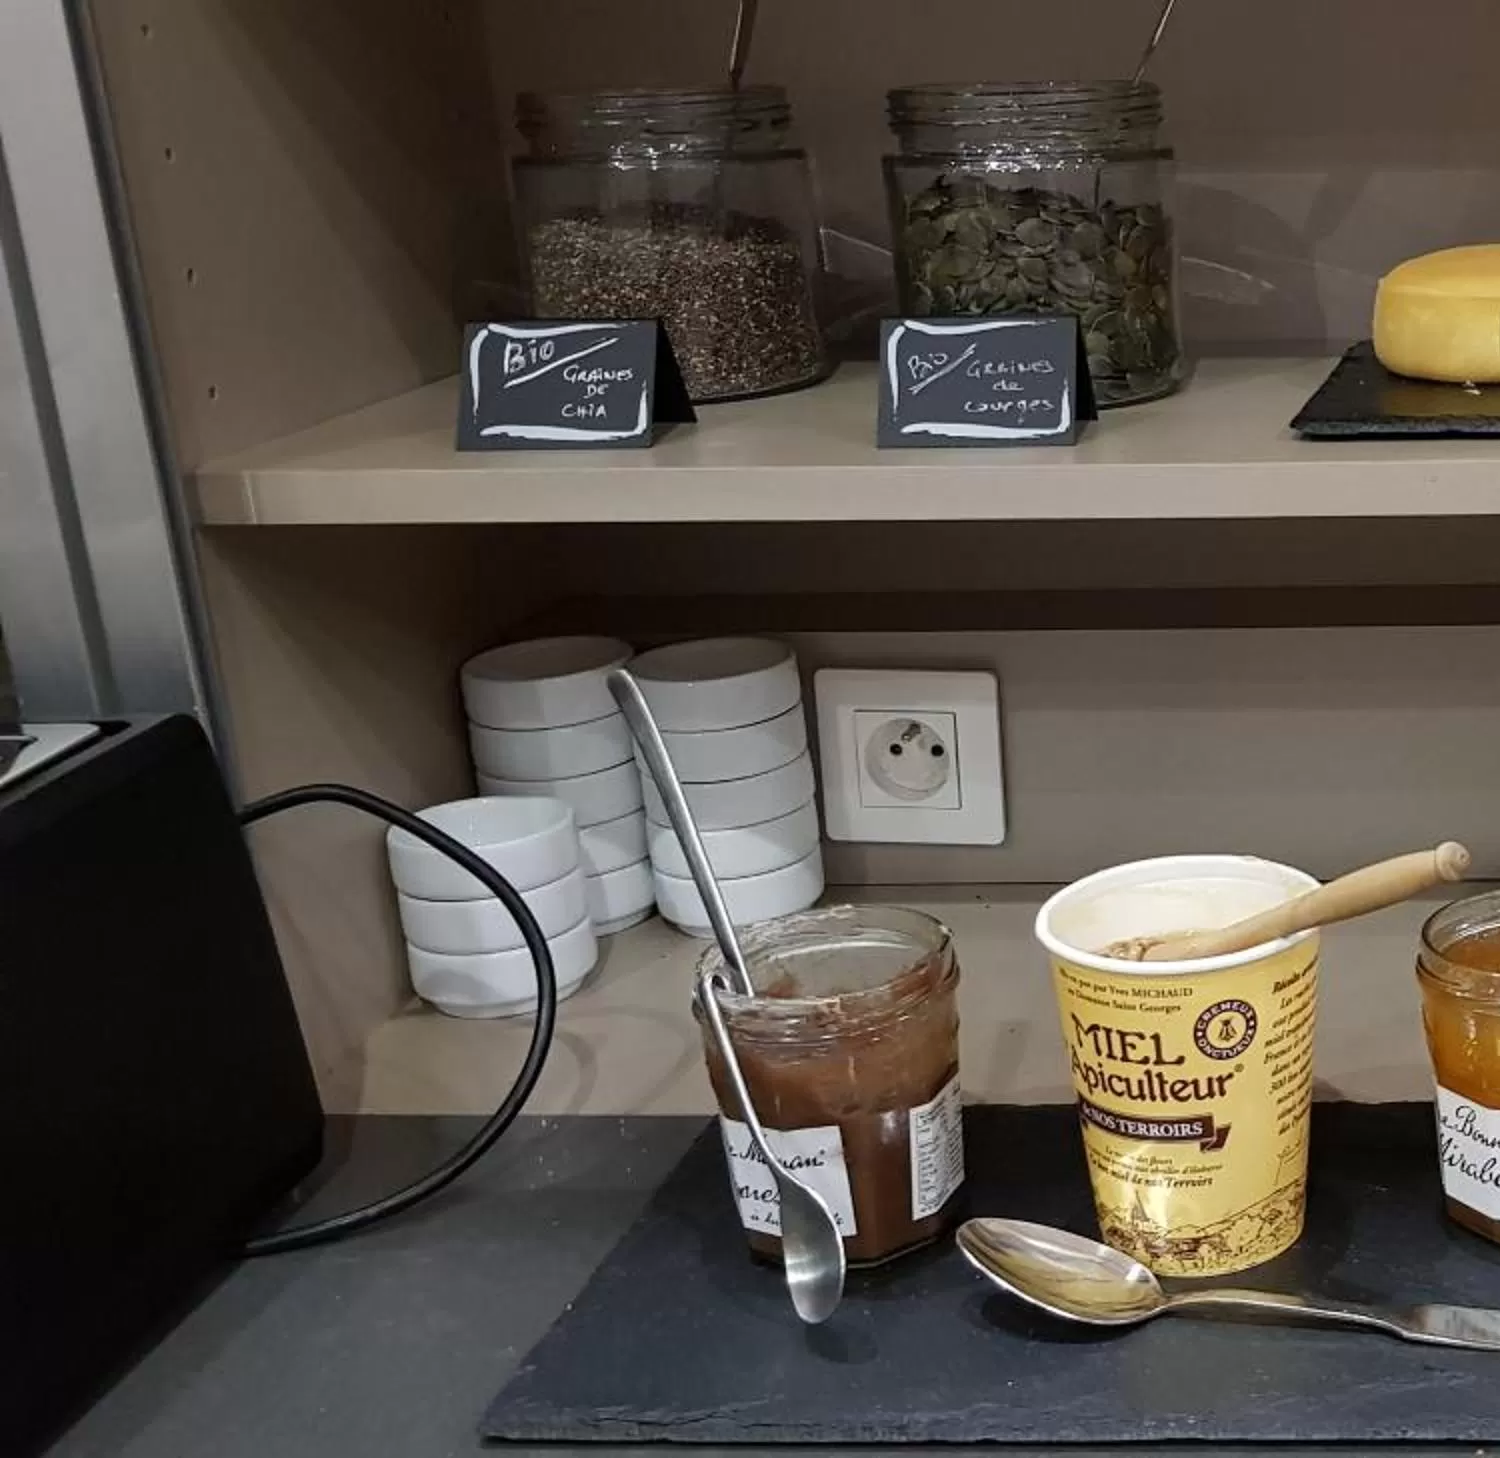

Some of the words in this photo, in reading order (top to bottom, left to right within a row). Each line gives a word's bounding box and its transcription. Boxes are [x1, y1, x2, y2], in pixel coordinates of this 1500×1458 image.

[504, 339, 555, 375] Bio
[907, 352, 949, 380] Bio
[1071, 1012, 1186, 1066] MIEL
[1115, 1118, 1204, 1137] TERROIRS
